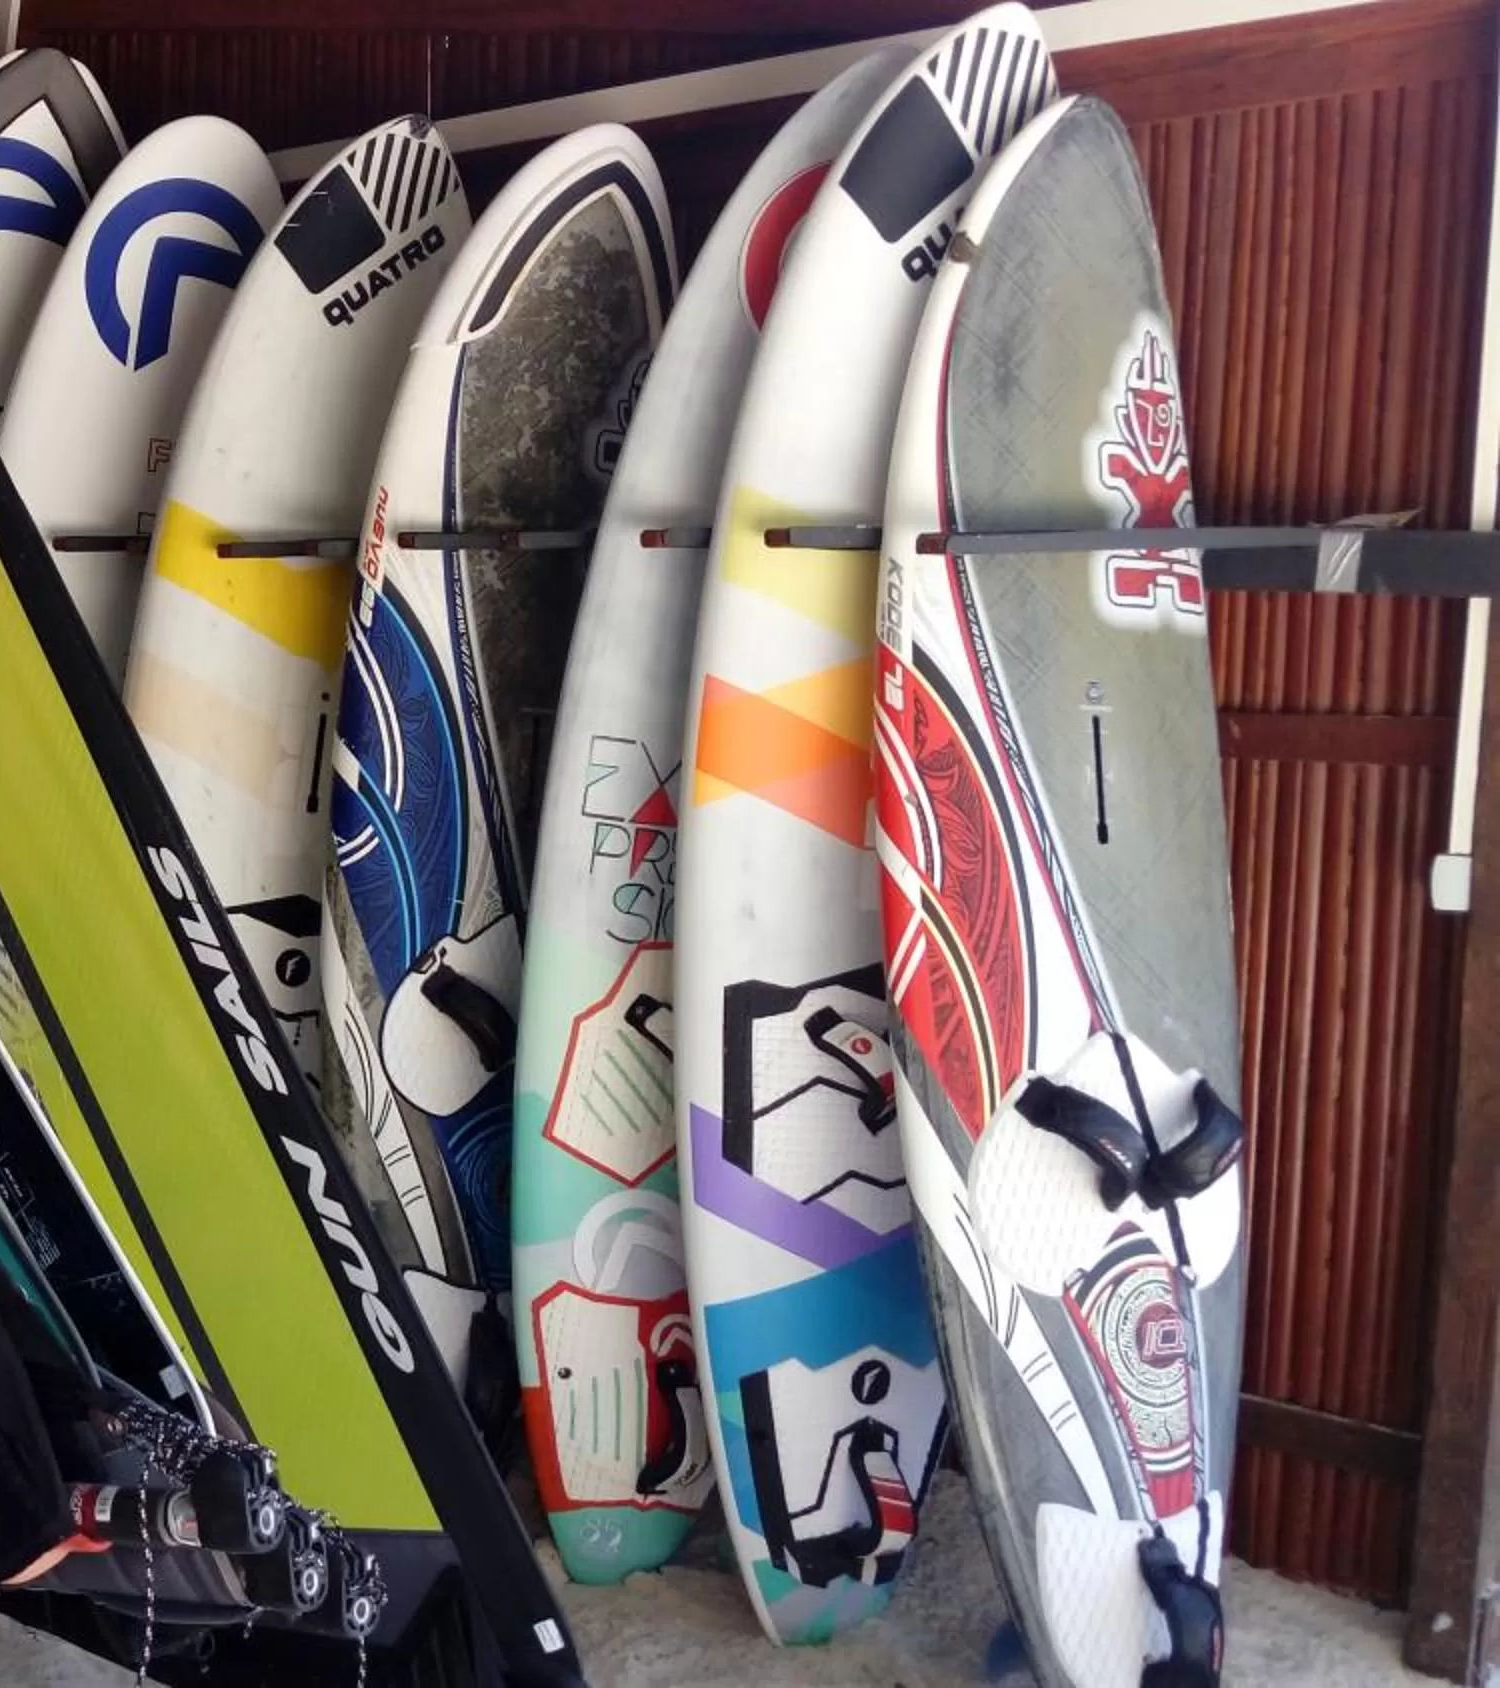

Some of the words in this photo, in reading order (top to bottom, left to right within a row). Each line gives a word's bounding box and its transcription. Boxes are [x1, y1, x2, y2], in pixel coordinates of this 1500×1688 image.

[322, 226, 446, 328] QUATRO
[885, 557, 905, 654] KODE
[148, 845, 290, 1097] SAILS
[281, 1136, 415, 1373] GUN
